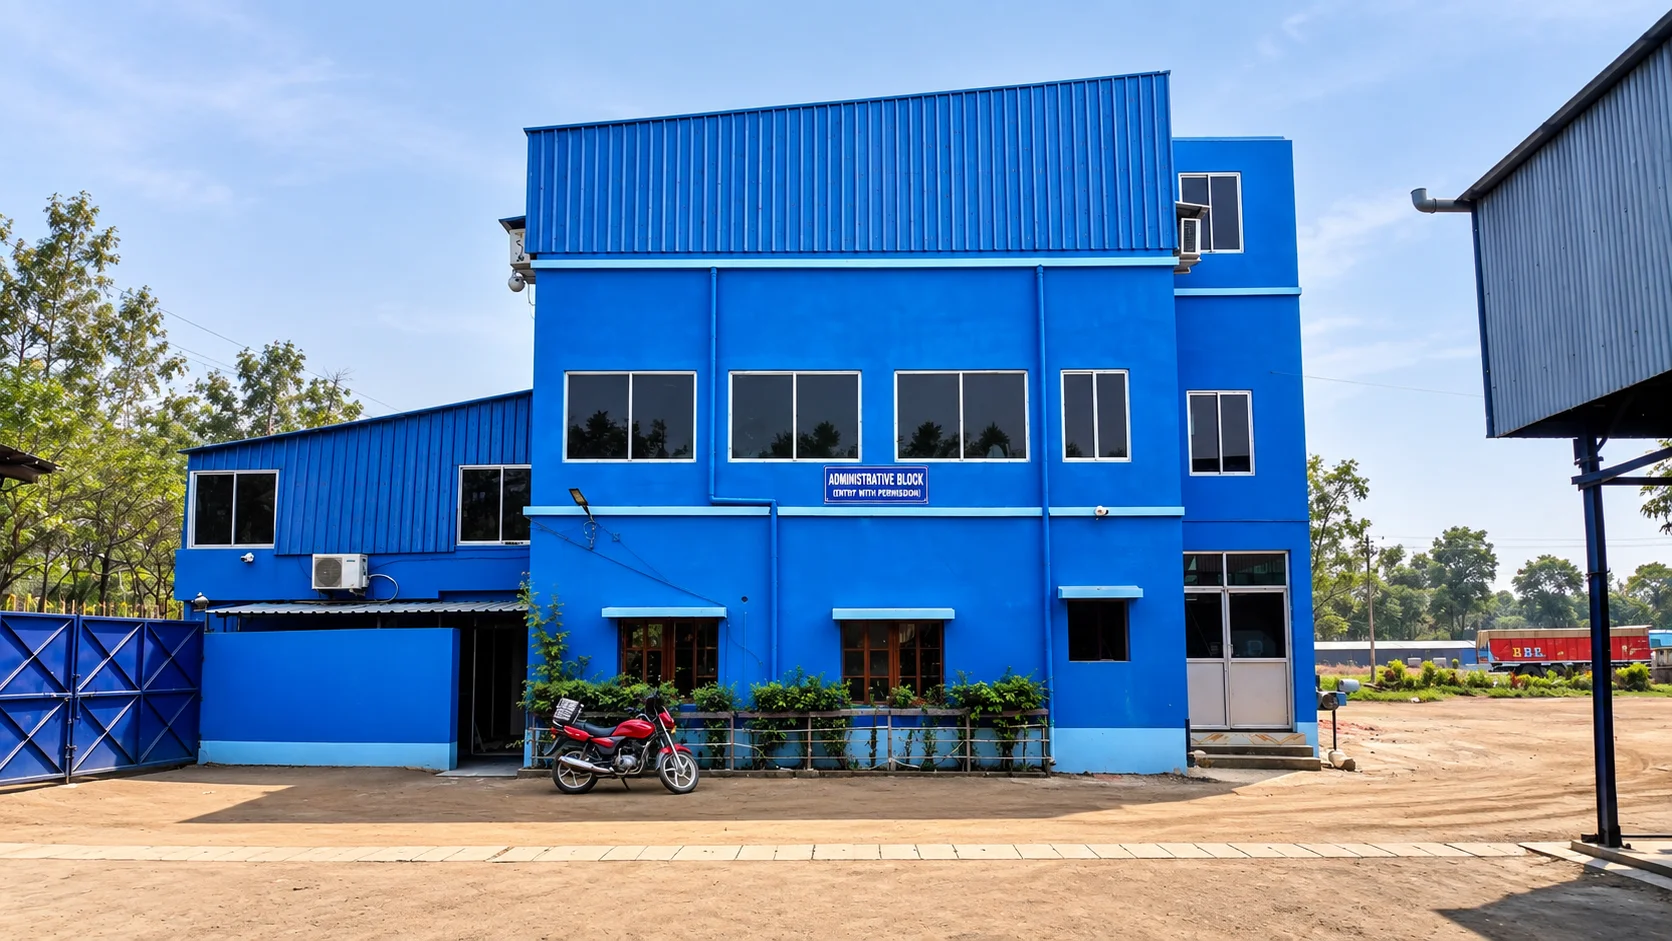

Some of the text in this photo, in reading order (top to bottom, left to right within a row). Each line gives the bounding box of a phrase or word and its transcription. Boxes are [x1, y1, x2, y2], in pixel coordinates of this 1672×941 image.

[828, 473, 924, 486] ADMINISTRATIVE BLOCK
[858, 489, 876, 497] WITH
